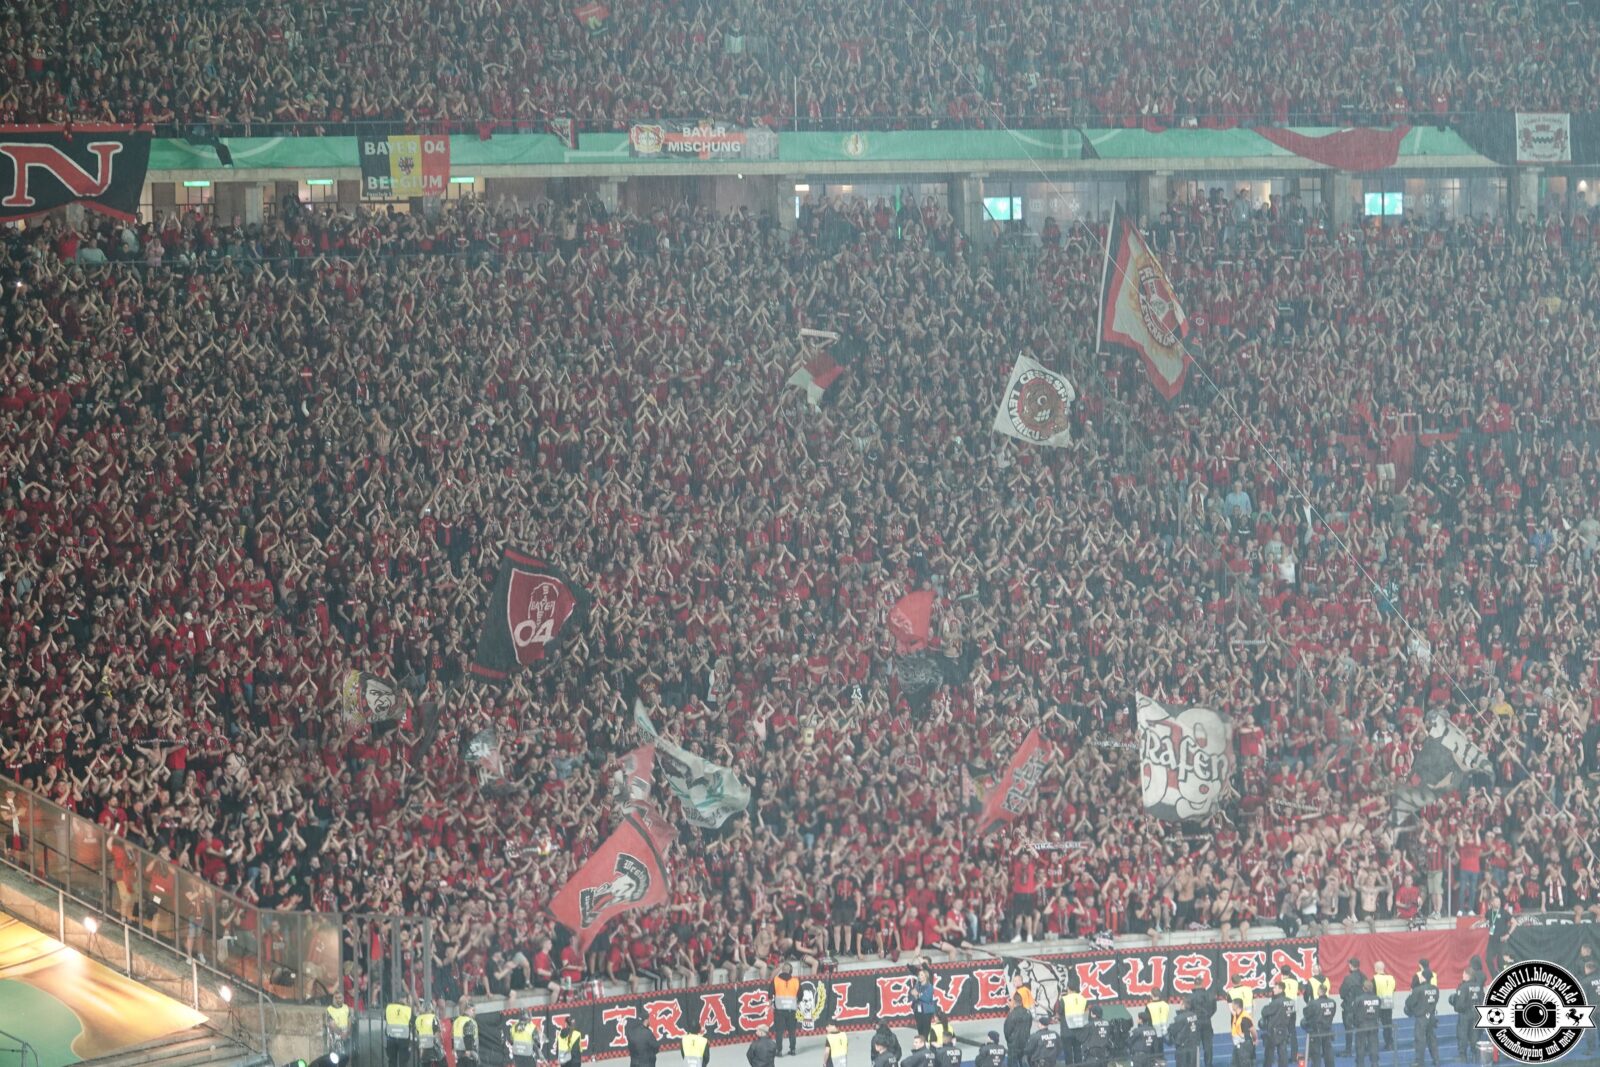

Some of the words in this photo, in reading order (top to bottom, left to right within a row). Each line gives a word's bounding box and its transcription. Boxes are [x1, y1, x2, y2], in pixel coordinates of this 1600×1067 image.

[682, 127, 726, 137] BAYER
[364, 141, 418, 155] BAYER
[424, 140, 446, 154] 04
[668, 142, 741, 152] MISCHUNG
[367, 175, 443, 190] BELGIUM
[513, 619, 555, 648] 04
[831, 947, 1317, 1021] LEVEKUSEN
